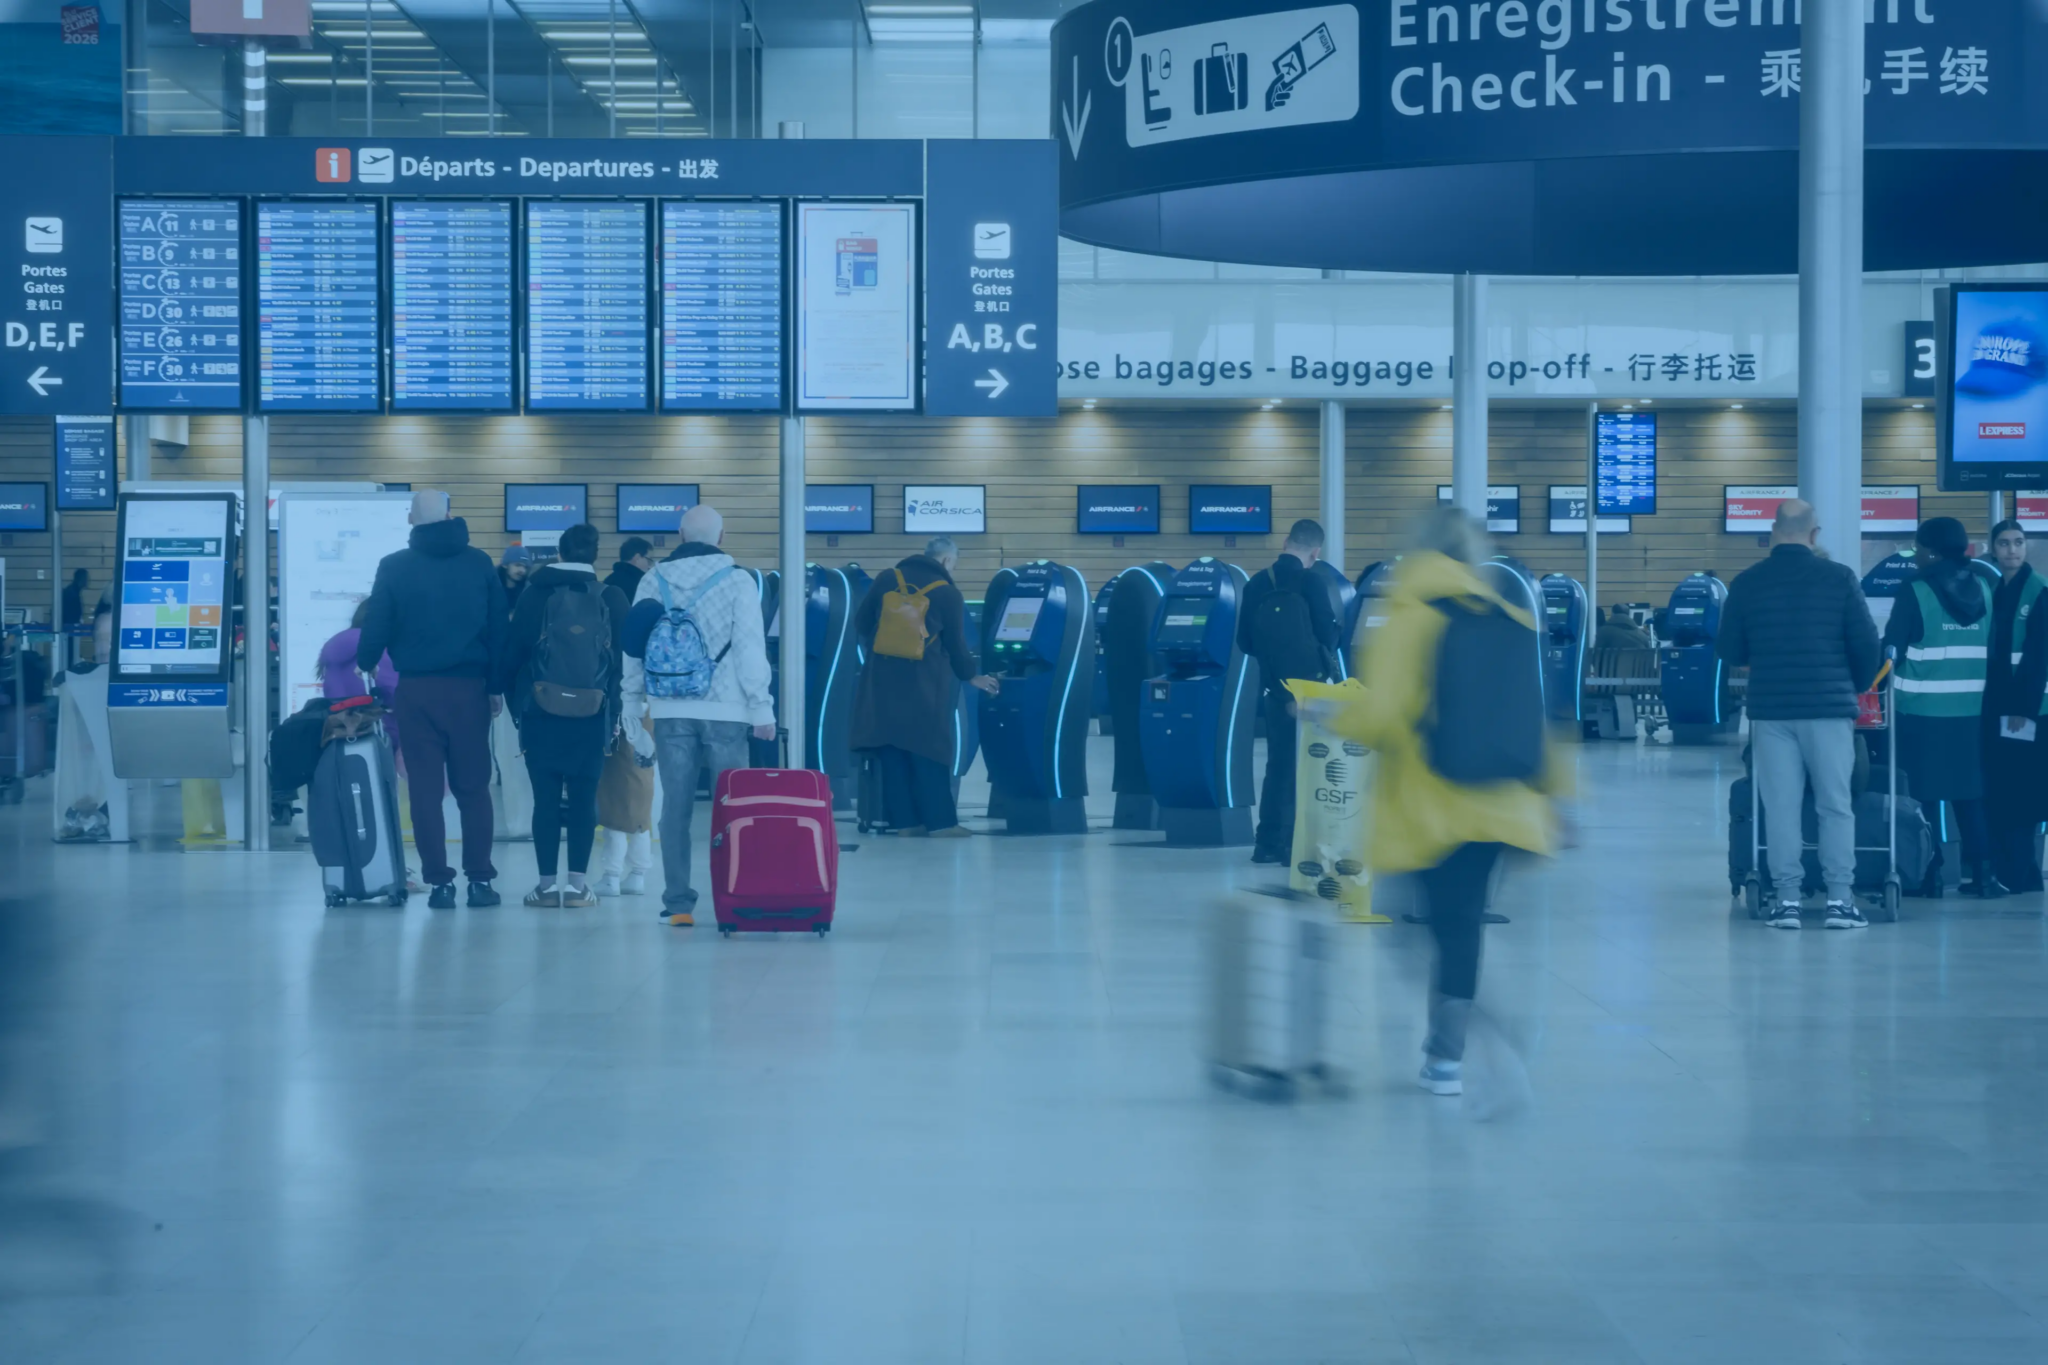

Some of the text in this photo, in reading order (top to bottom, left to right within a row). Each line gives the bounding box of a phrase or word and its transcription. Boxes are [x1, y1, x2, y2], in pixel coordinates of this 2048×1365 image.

[63, 15, 99, 33] CLIENT
[1390, 0, 1935, 50] Enregistremnt
[63, 33, 99, 45] 2026
[1390, 51, 1672, 116] Check-in
[1759, 46, 1990, 98] 乘手续
[400, 156, 496, 182] Départs
[519, 157, 655, 182] Departures
[678, 158, 719, 179] 出发
[141, 216, 179, 232] A 11
[142, 245, 174, 261] B 9
[21, 264, 68, 277] Portes
[970, 266, 1015, 279] Portes
[23, 281, 65, 294] Gates
[142, 274, 180, 290] C 13
[972, 283, 1013, 296] Gates
[25, 298, 63, 311] 登机口
[142, 303, 183, 319] D 30
[973, 300, 1010, 312] 登机口
[5, 322, 85, 352] D,E,F
[143, 332, 183, 347] E 26
[947, 323, 1037, 353] A,B,C
[1913, 338, 1936, 379] 3
[143, 360, 183, 376] F 30
[1115, 353, 1253, 386] bagages
[1290, 355, 1433, 387] Baggage
[1627, 352, 1757, 382] 行李托运
[919, 507, 983, 515] CORSICA
[1314, 787, 1359, 805] GSF
